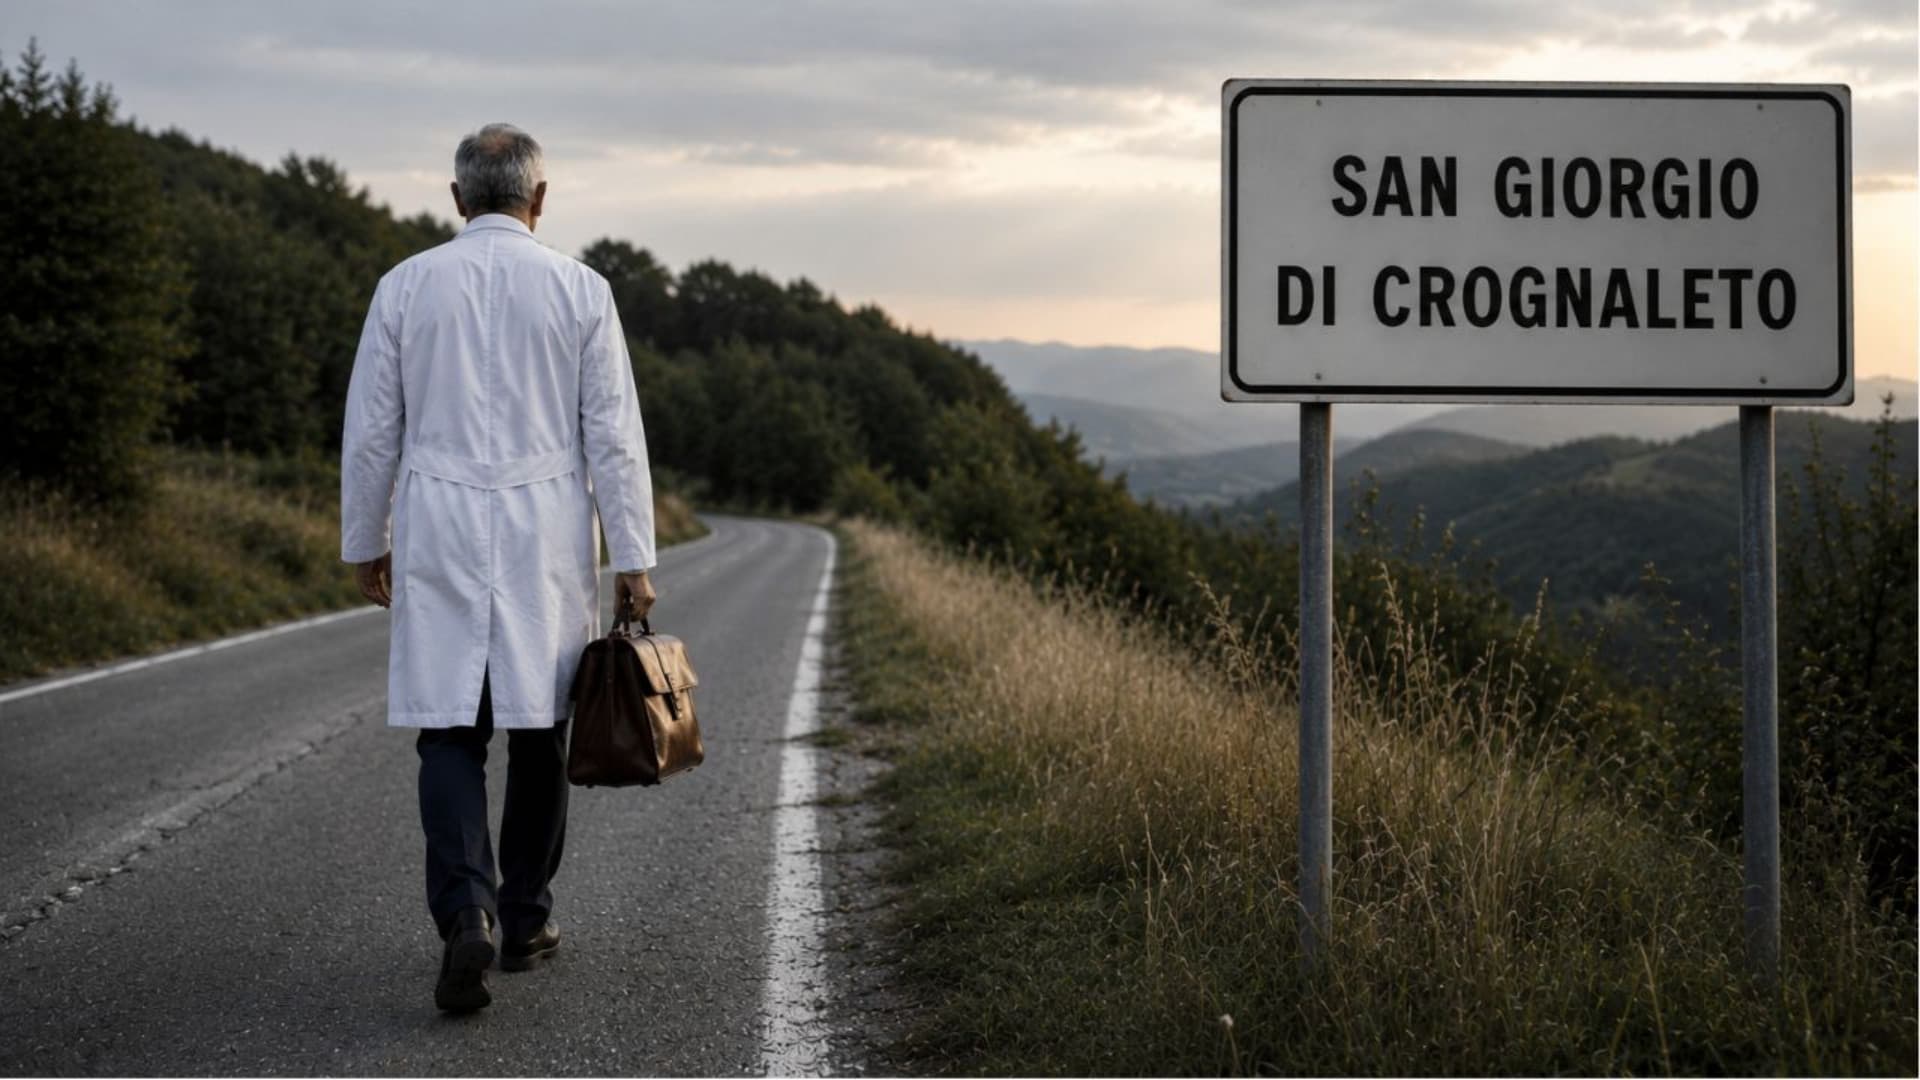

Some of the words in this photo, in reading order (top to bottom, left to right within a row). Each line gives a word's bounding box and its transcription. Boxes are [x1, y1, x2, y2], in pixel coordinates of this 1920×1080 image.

[1331, 154, 1458, 218] SAN
[1494, 156, 1760, 221] GIORGIO
[1277, 265, 1336, 327] DI
[1372, 265, 1798, 331] CROGNALETO
